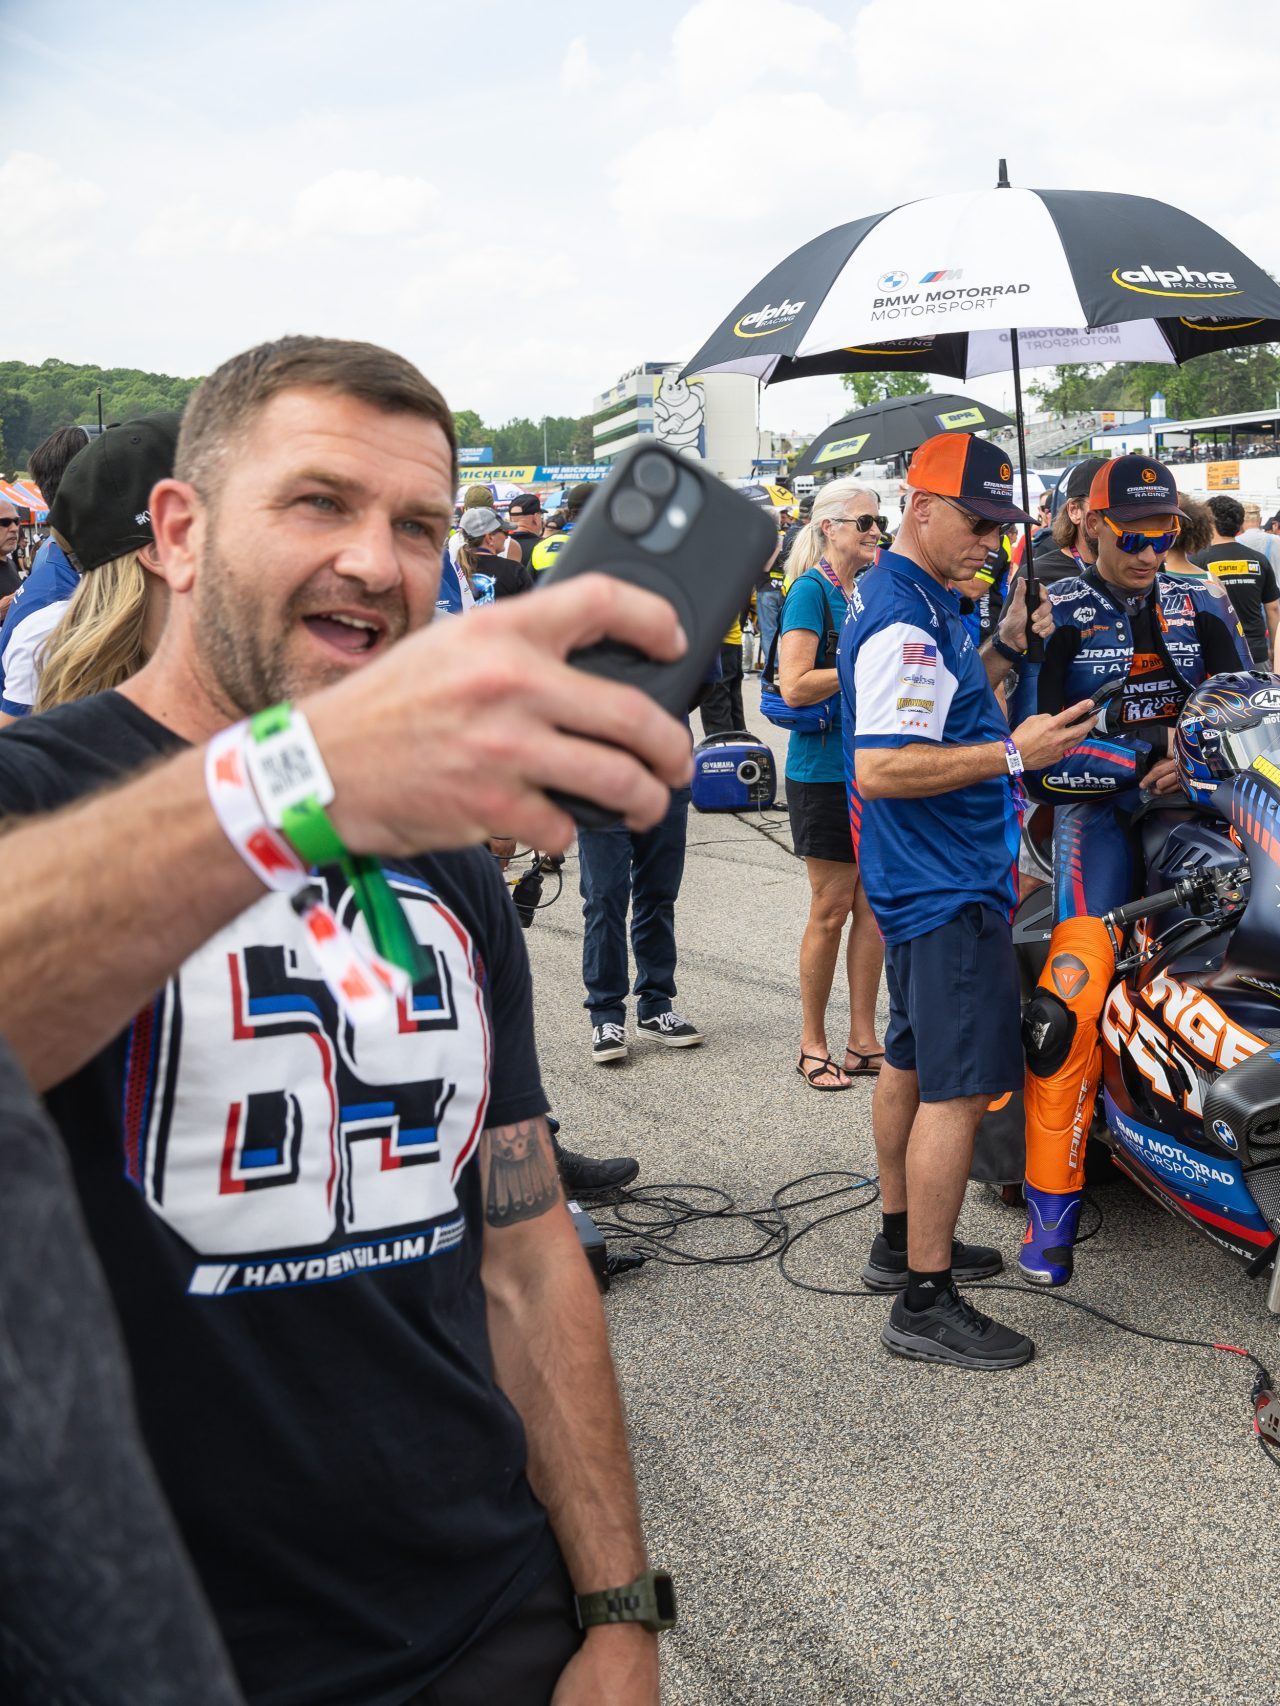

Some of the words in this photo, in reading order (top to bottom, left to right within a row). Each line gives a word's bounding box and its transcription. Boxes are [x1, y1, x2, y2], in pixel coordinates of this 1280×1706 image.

[1121, 265, 1235, 288] alpha
[1172, 282, 1238, 290] RACING
[873, 294, 919, 309] BMW
[925, 284, 1031, 303] MOTORRAD
[742, 299, 806, 328] alpha
[870, 298, 998, 322] MOTORSPORT
[760, 315, 796, 328] RACING
[459, 469, 526, 480] MICHELIN
[542, 466, 556, 474] THE
[551, 472, 584, 481] FAMILY
[1047, 772, 1117, 788] alpha
[145, 872, 491, 1257] 69
[1115, 1115, 1144, 1146] BMW
